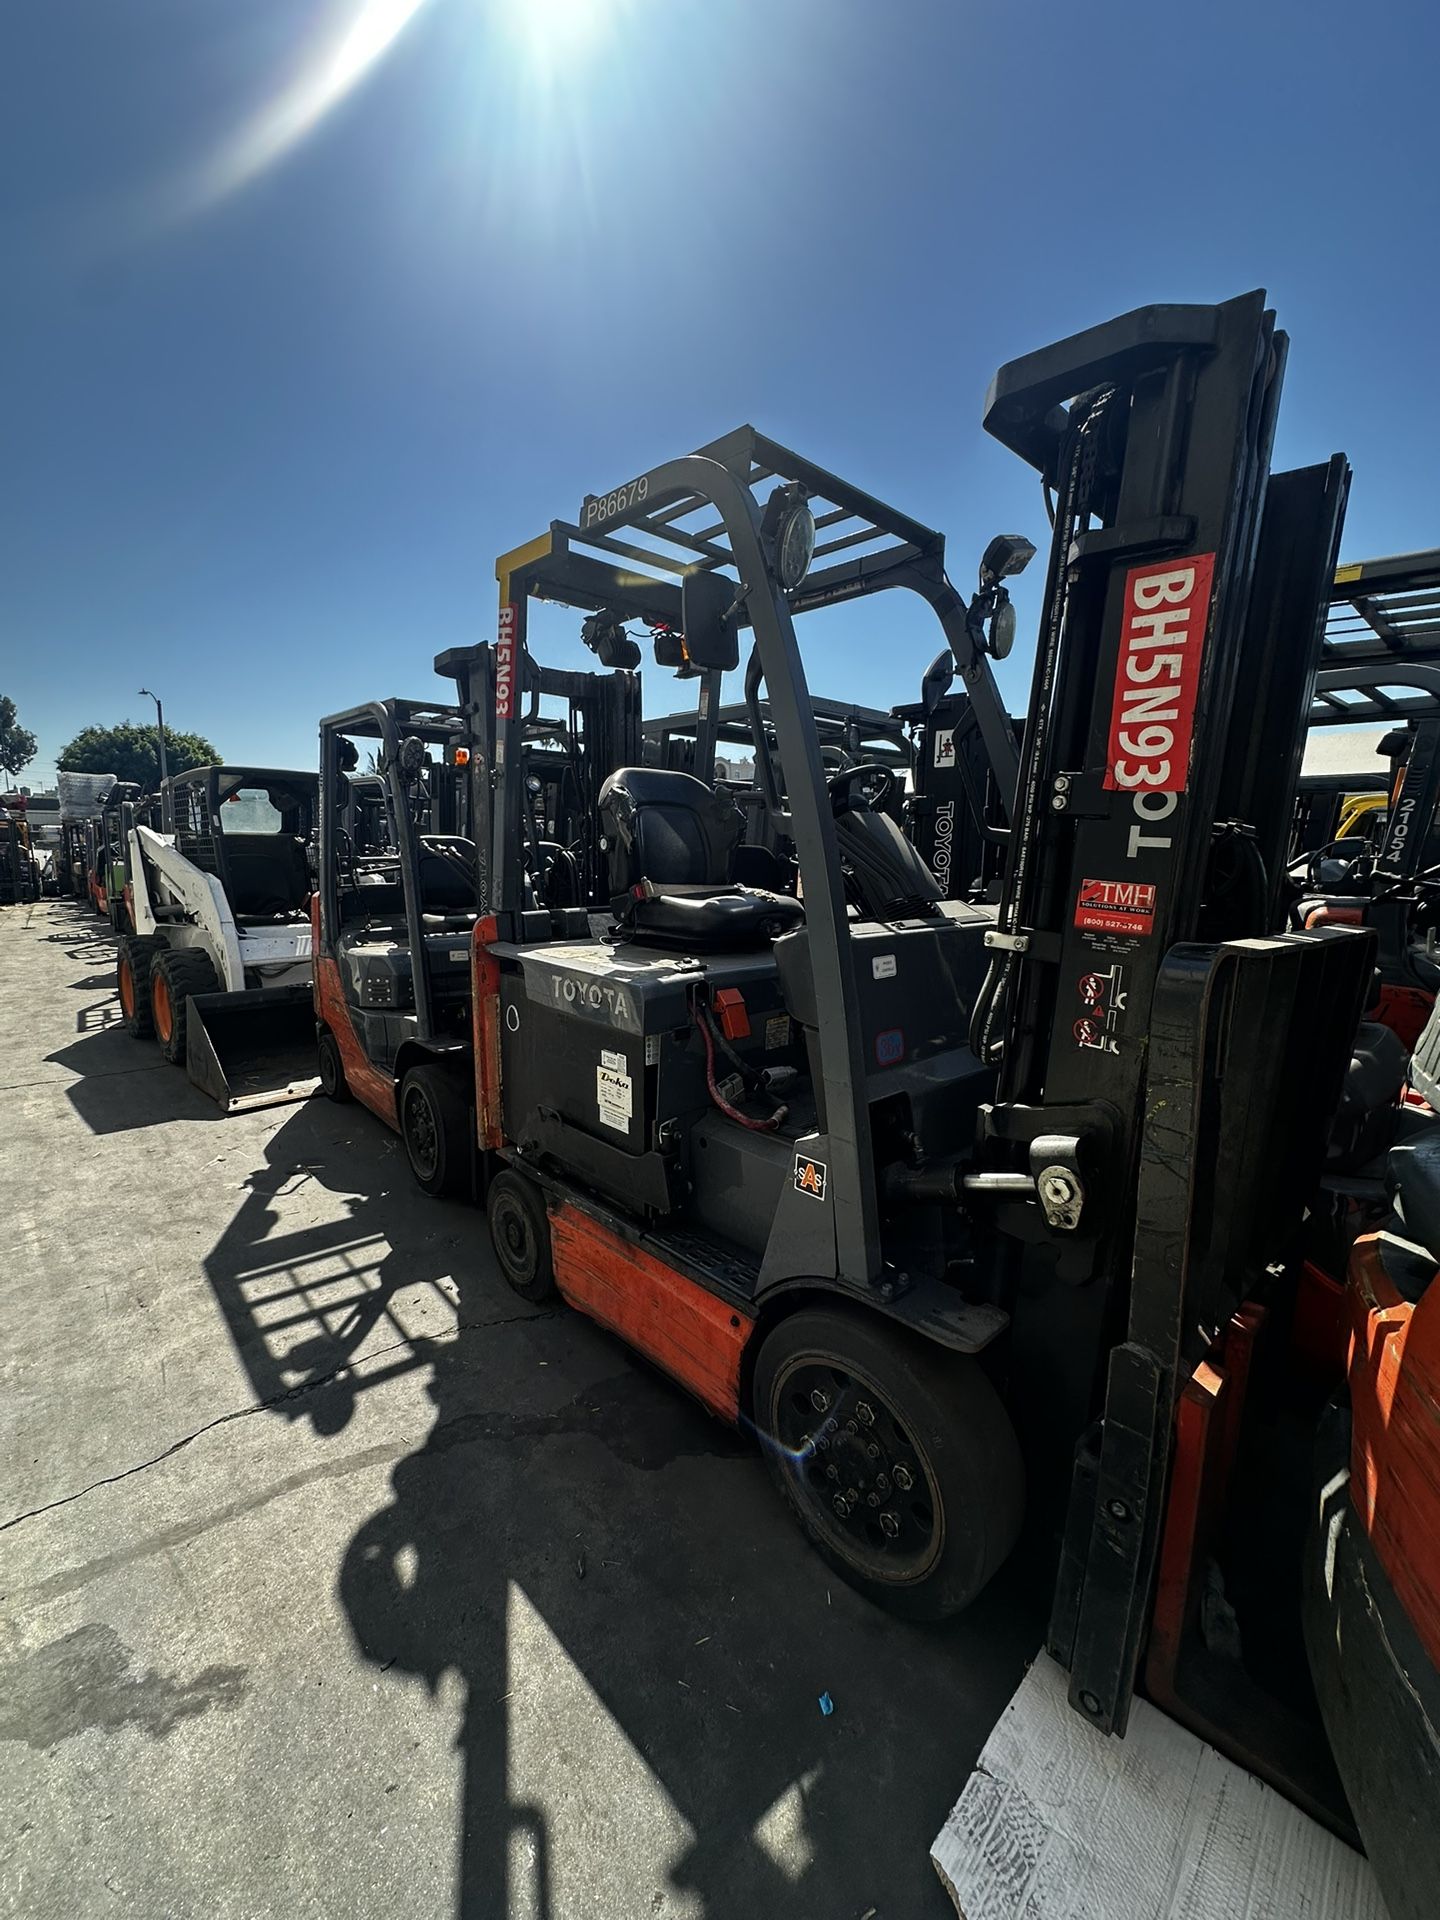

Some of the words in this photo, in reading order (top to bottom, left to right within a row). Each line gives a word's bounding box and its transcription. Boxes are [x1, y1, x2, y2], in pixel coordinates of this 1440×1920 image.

[586, 476, 649, 527] P86679
[495, 607, 514, 716] BH5N93
[1114, 567, 1196, 788] BH5N93
[1386, 798, 1417, 863] 21054
[1081, 901, 1117, 910] SOLUTIONS
[1100, 882, 1154, 907] TMH
[551, 974, 628, 1018] TOYOTA
